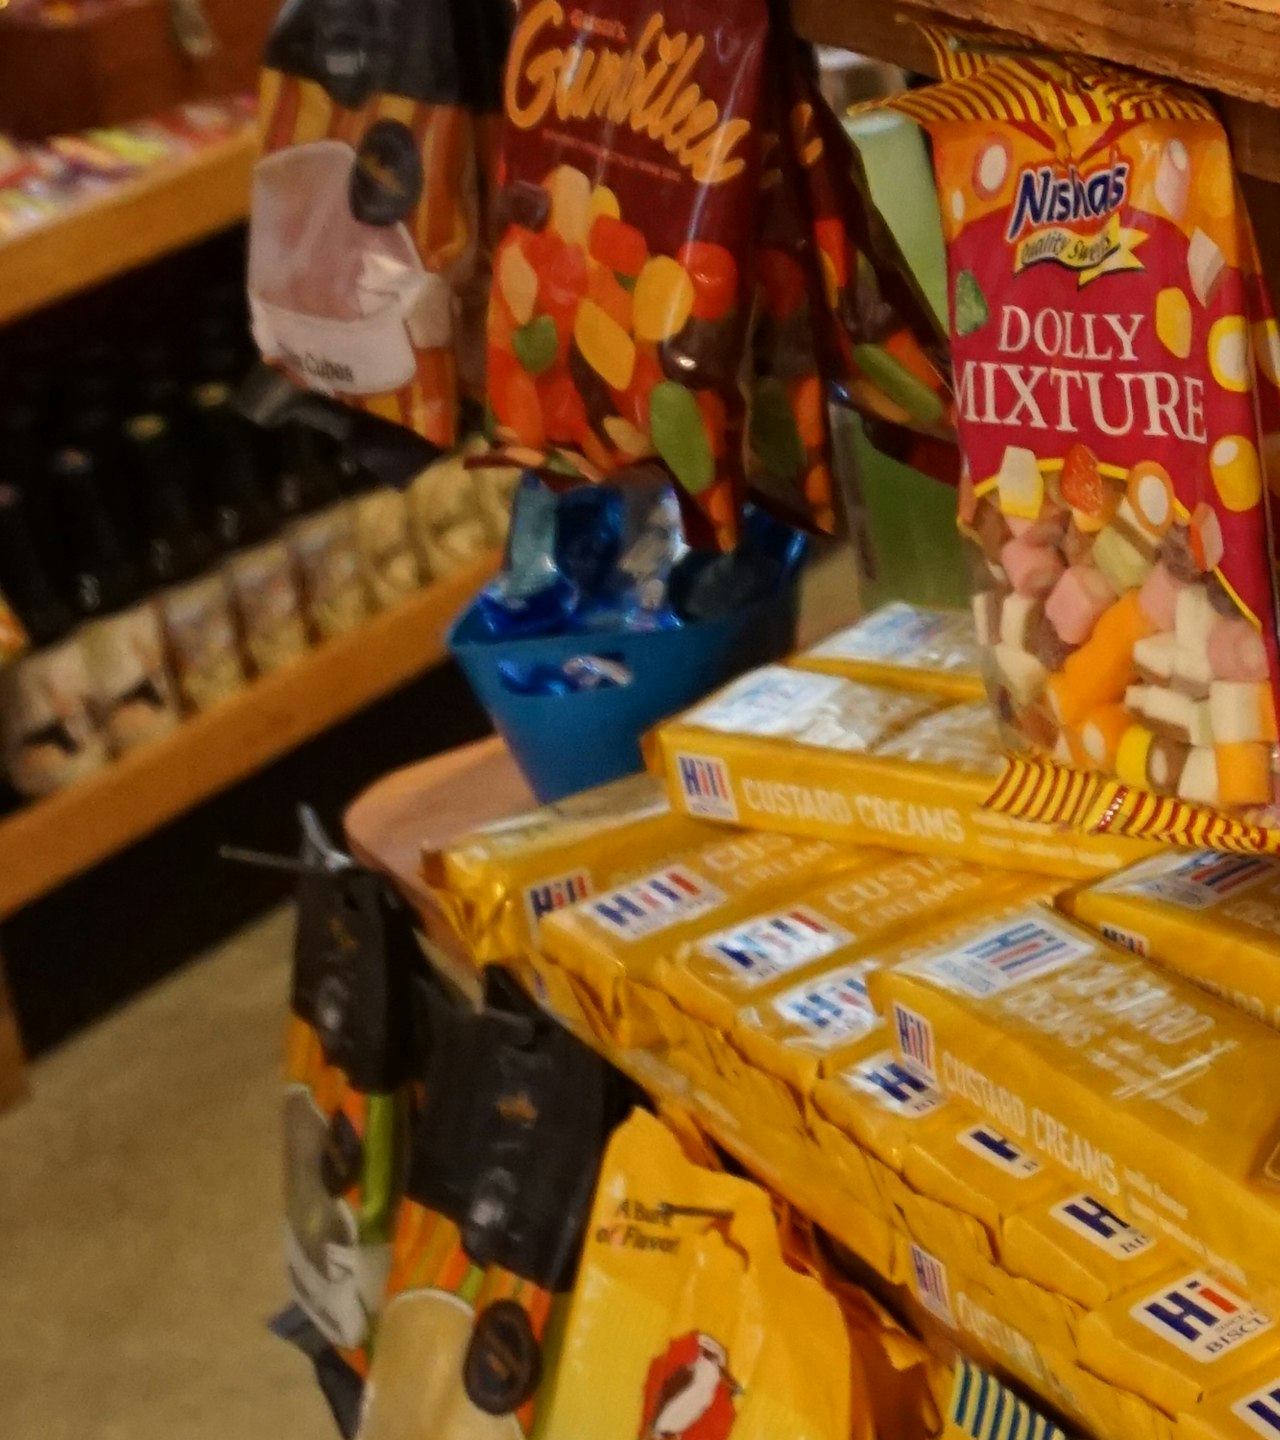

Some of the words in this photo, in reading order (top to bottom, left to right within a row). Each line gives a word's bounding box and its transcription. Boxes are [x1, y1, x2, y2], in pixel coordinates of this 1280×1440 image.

[1006, 164, 1128, 244] Nisha's
[998, 305, 1145, 361] DOLLY
[955, 359, 1209, 445] MIXTURE
[680, 756, 731, 801] Hill
[741, 777, 850, 821] CUSTARD
[856, 794, 965, 844] CREAMS
[595, 865, 701, 927] Hill
[1031, 1105, 1120, 1197] CREAMS
